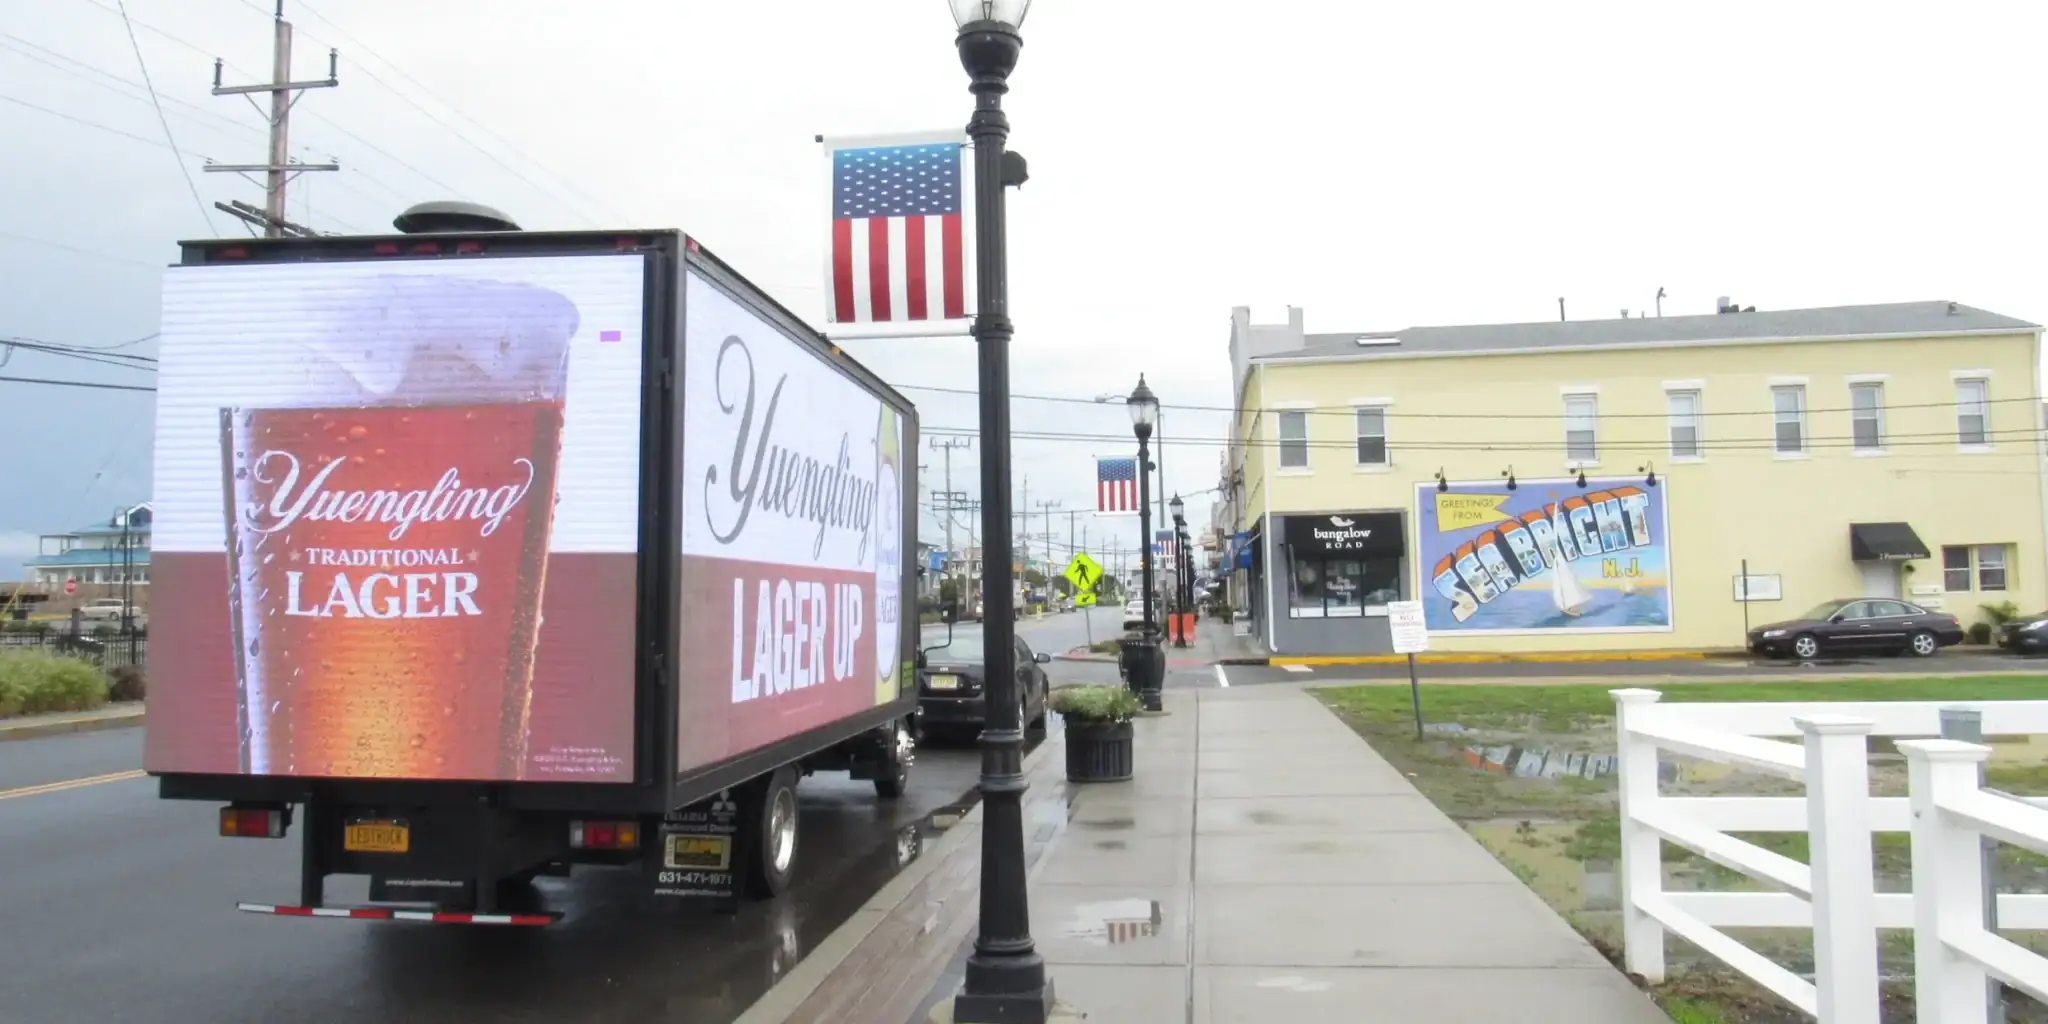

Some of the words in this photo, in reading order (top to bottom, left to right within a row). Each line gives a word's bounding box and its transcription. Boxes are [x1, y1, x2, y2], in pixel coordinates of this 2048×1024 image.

[705, 334, 878, 566] Yuengling
[246, 449, 533, 540] Yuengling
[1440, 499, 1494, 509] GREETINGS
[1453, 511, 1483, 520] FROM
[1313, 527, 1372, 542] bungalow
[1325, 541, 1364, 550] ROAD
[304, 547, 464, 567] TRADITIONAL
[1432, 532, 1521, 623] SEA
[1500, 488, 1651, 578] BRIGHT
[284, 571, 482, 619] LAGER
[731, 577, 828, 704] LAGER
[831, 581, 864, 682] UP
[350, 827, 403, 845] LEDTRUCK
[658, 871, 733, 885] 631-471-1971
